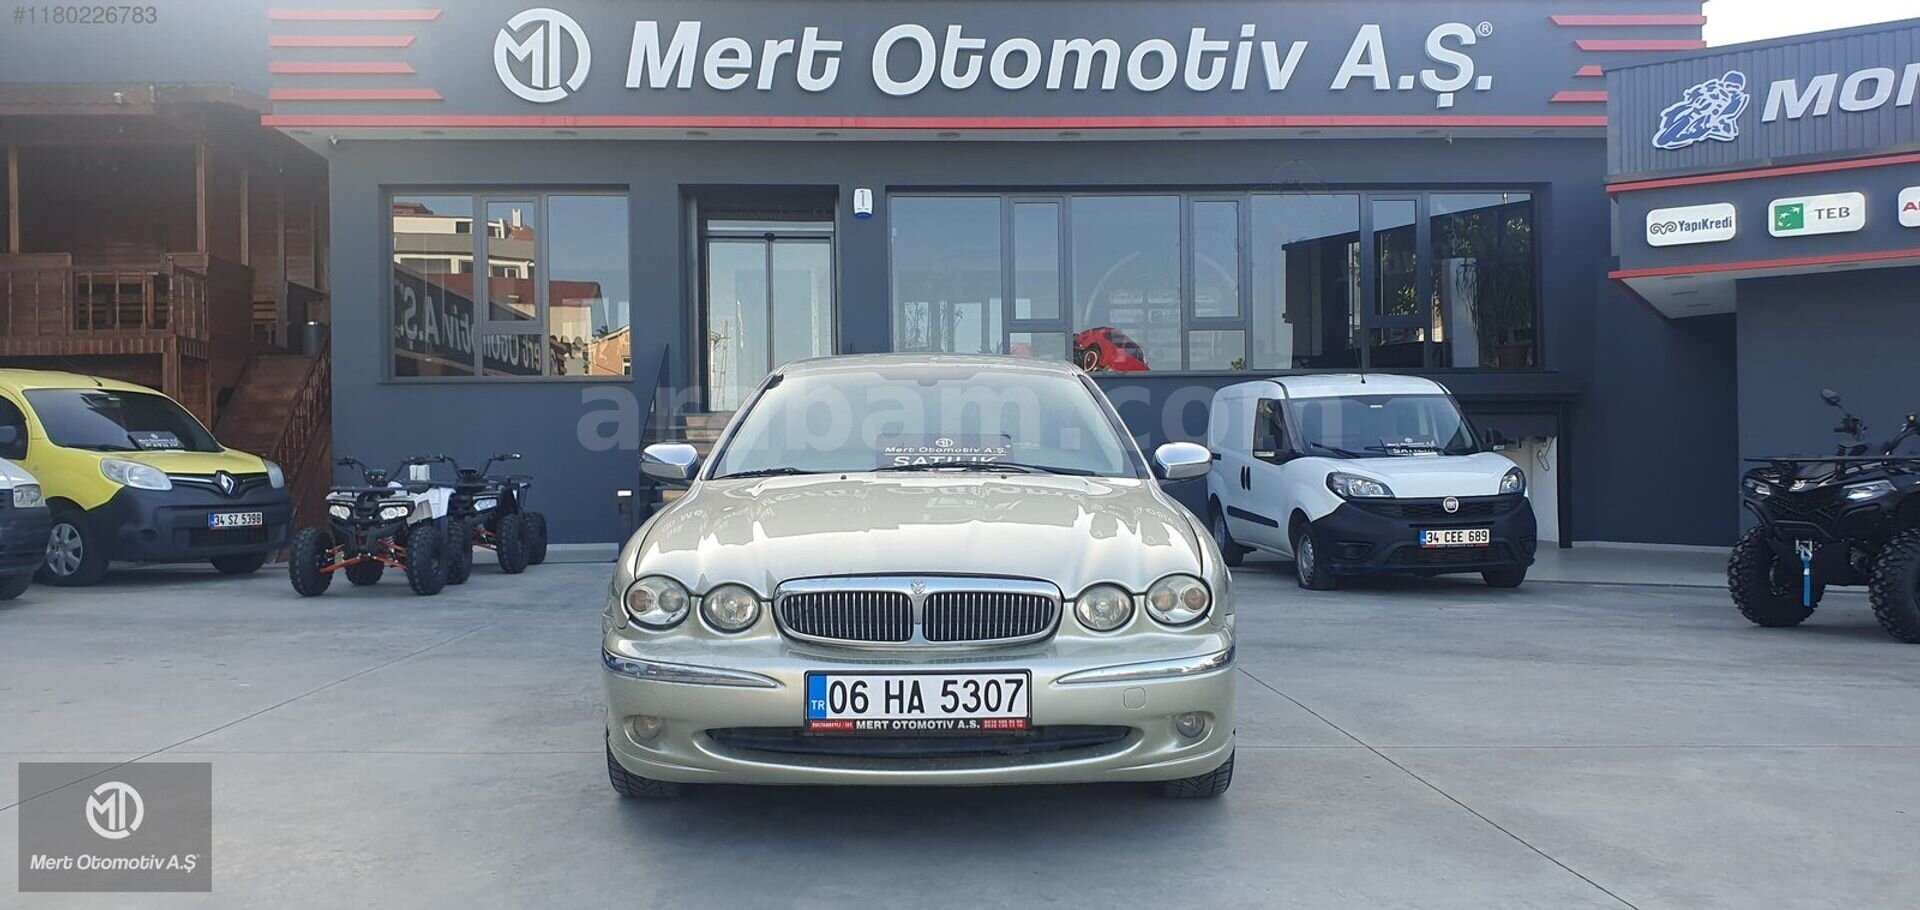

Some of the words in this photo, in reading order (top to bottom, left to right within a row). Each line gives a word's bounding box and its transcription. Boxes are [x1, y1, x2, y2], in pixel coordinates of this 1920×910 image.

[625, 21, 843, 92] Mert
[871, 23, 1308, 96] Otomotiv
[1814, 207, 1850, 220] TEB
[214, 514, 225, 526] 34
[228, 514, 238, 525] SZ
[1427, 531, 1439, 543] 34
[1444, 531, 1463, 543] CEE
[1468, 530, 1488, 542] 689
[829, 680, 869, 714] 06
[884, 680, 925, 714] HA
[941, 679, 1024, 714] 5307
[811, 700, 825, 710] TR
[856, 719, 888, 730] MERT
